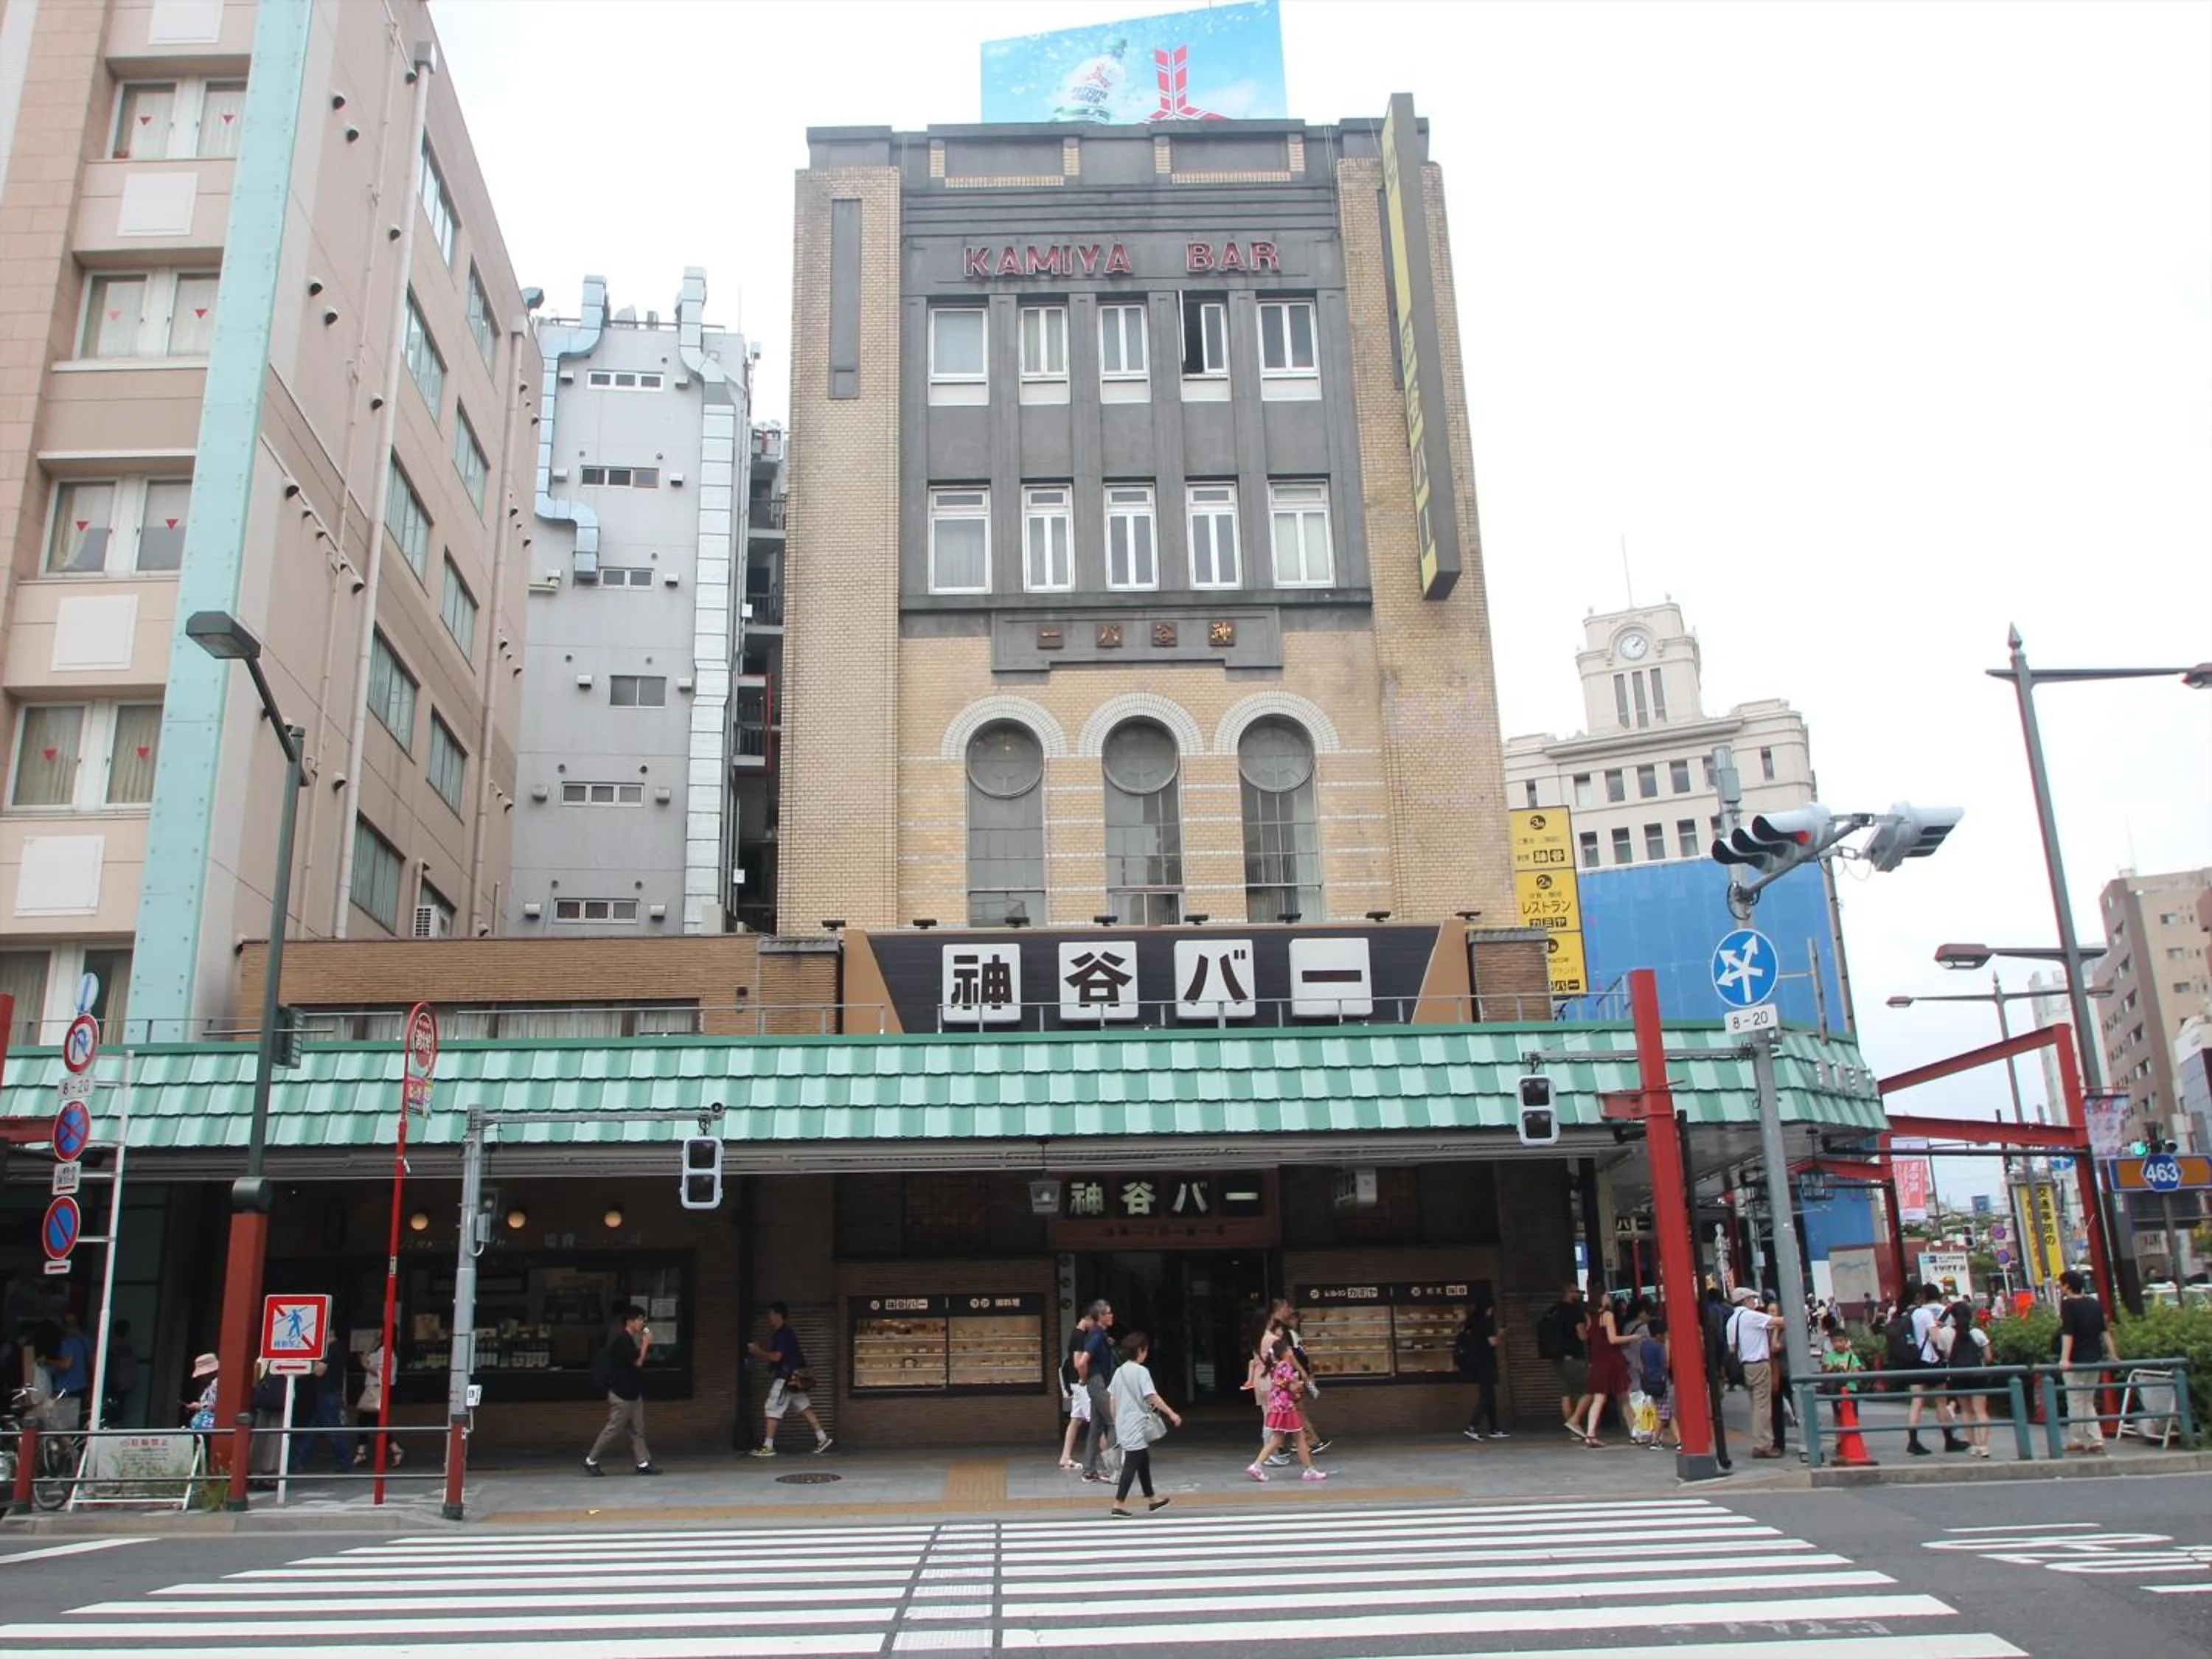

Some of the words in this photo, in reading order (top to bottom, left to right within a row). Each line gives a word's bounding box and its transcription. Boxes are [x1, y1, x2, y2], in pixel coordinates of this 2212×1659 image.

[964, 244, 1133, 277] KAMIYA
[1186, 241, 1281, 274] BAR
[1522, 900, 1571, 914] レストラン
[950, 950, 1362, 1009] 神谷バー
[1551, 979, 1580, 992] バー
[1732, 1012, 1769, 1028] 8-20
[62, 1079, 89, 1096] 8-20
[2146, 1162, 2179, 1182] 463
[1070, 1181, 1259, 1215] 神谷バー
